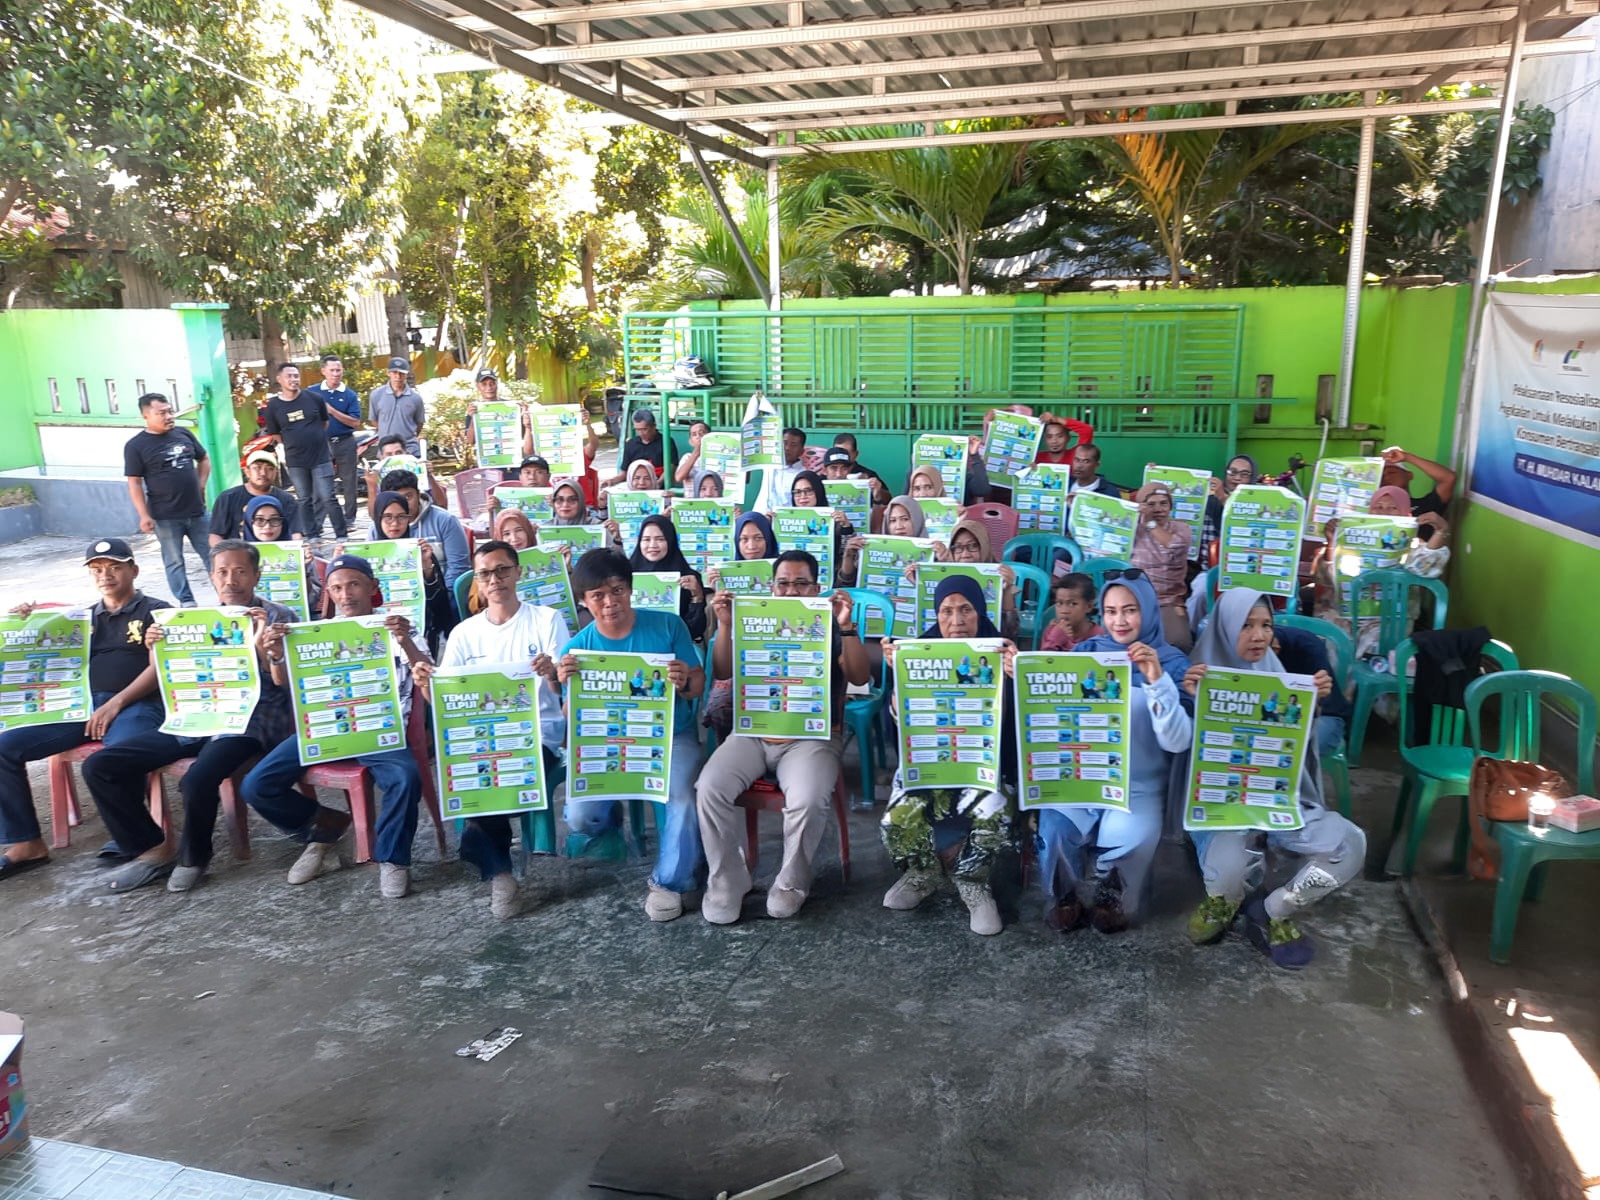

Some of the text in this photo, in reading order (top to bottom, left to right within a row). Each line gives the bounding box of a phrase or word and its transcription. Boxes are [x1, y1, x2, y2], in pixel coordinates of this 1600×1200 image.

[742, 617, 777, 626] TEMAN
[157, 624, 208, 635] TEMAN
[744, 625, 774, 634] ELPIJI
[296, 641, 334, 653] TEMAN
[300, 650, 332, 661] ELPIJI
[904, 659, 952, 670] TEMAN
[579, 669, 627, 682] TEMAN
[909, 669, 948, 681] ELPIJI
[1025, 672, 1077, 684] TEMAN
[583, 680, 622, 692] ELPIJI
[1030, 682, 1073, 695] ELPIJI
[441, 692, 479, 704] TEMAN
[1208, 689, 1260, 704] TEMAN
[446, 700, 477, 711] ELPIJI
[1210, 701, 1254, 716] ELPIJI
